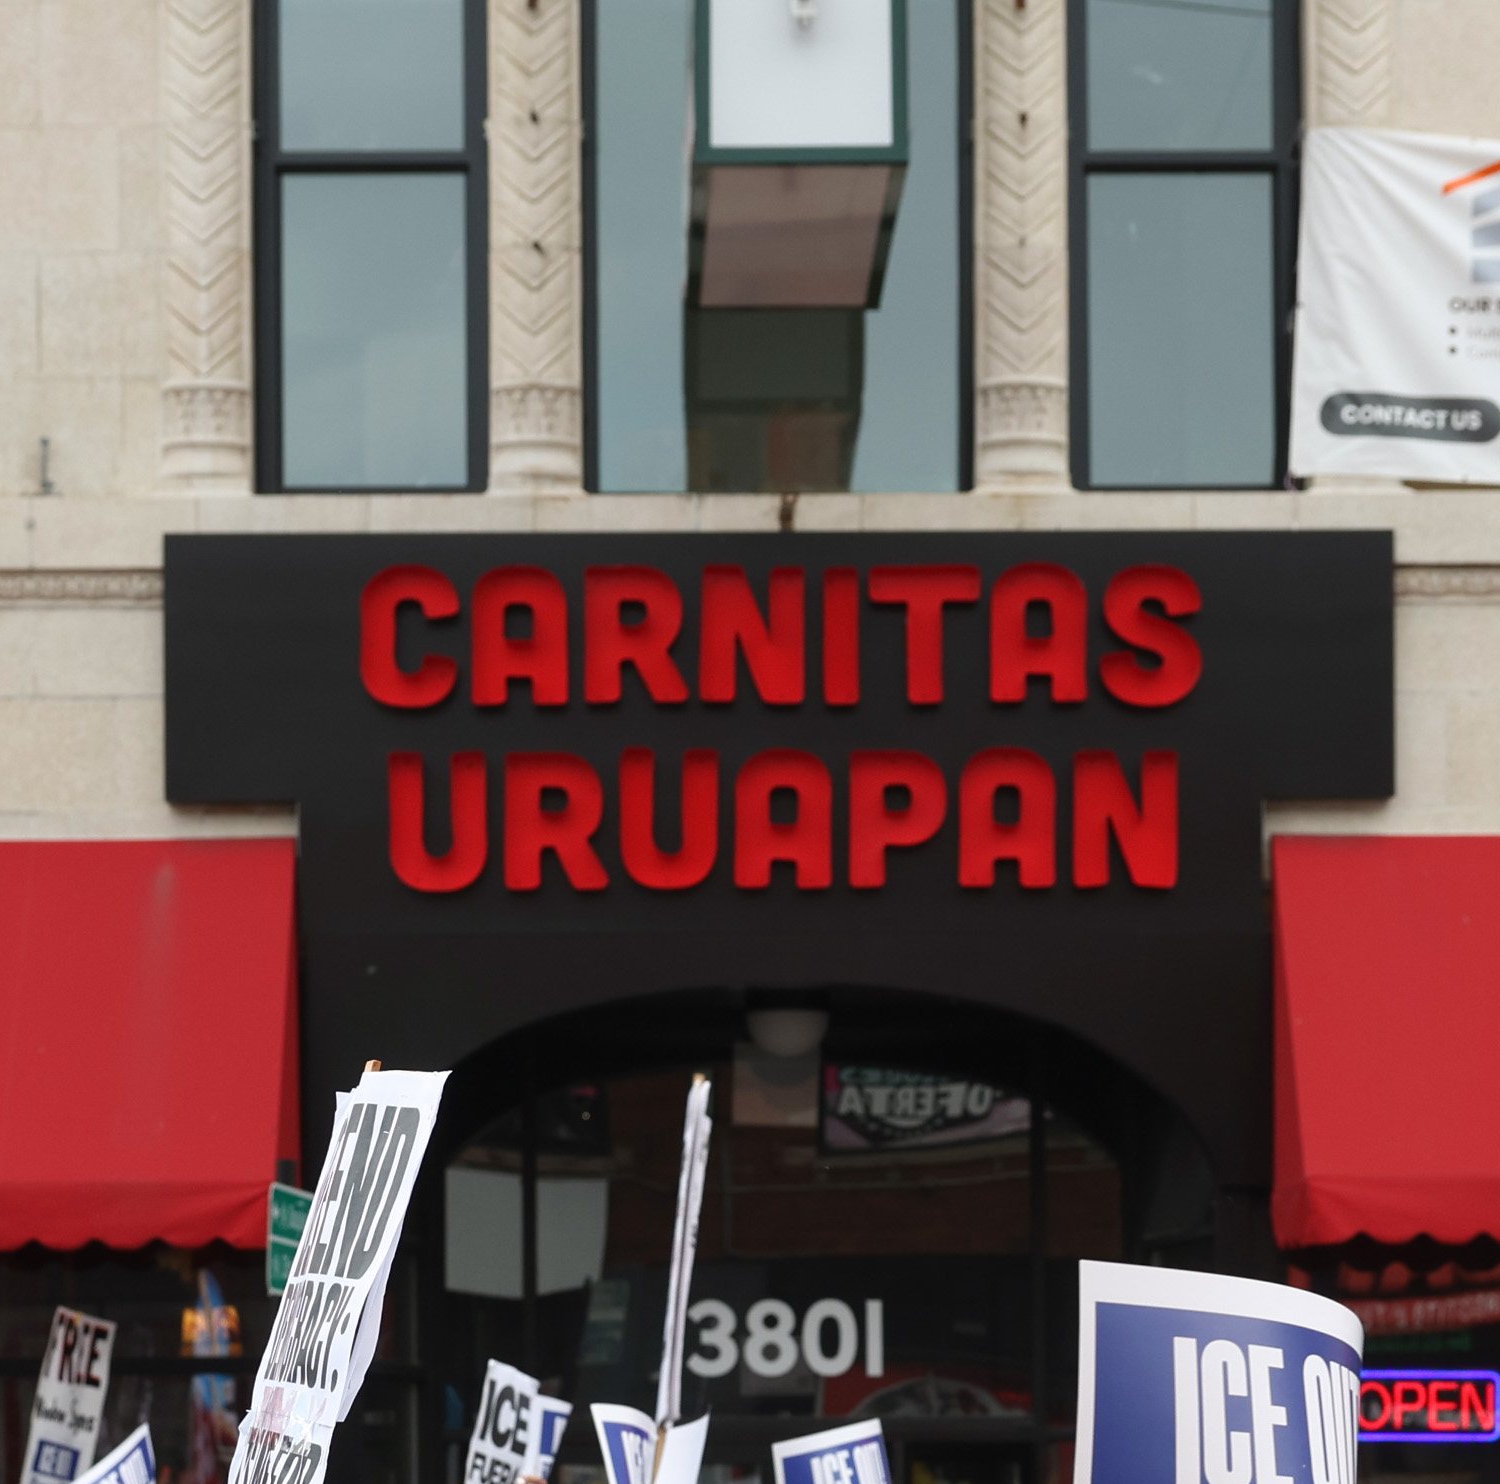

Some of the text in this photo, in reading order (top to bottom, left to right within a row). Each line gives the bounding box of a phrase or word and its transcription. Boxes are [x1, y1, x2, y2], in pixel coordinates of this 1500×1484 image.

[1448, 298, 1492, 316] OUR
[1340, 402, 1483, 432] CONTACT US
[360, 562, 1204, 708] CARNITAS
[387, 746, 1180, 893] URUAPAN
[685, 1298, 884, 1379] 3801
[479, 1379, 531, 1456] ICE
[1358, 1379, 1496, 1432] OPEN
